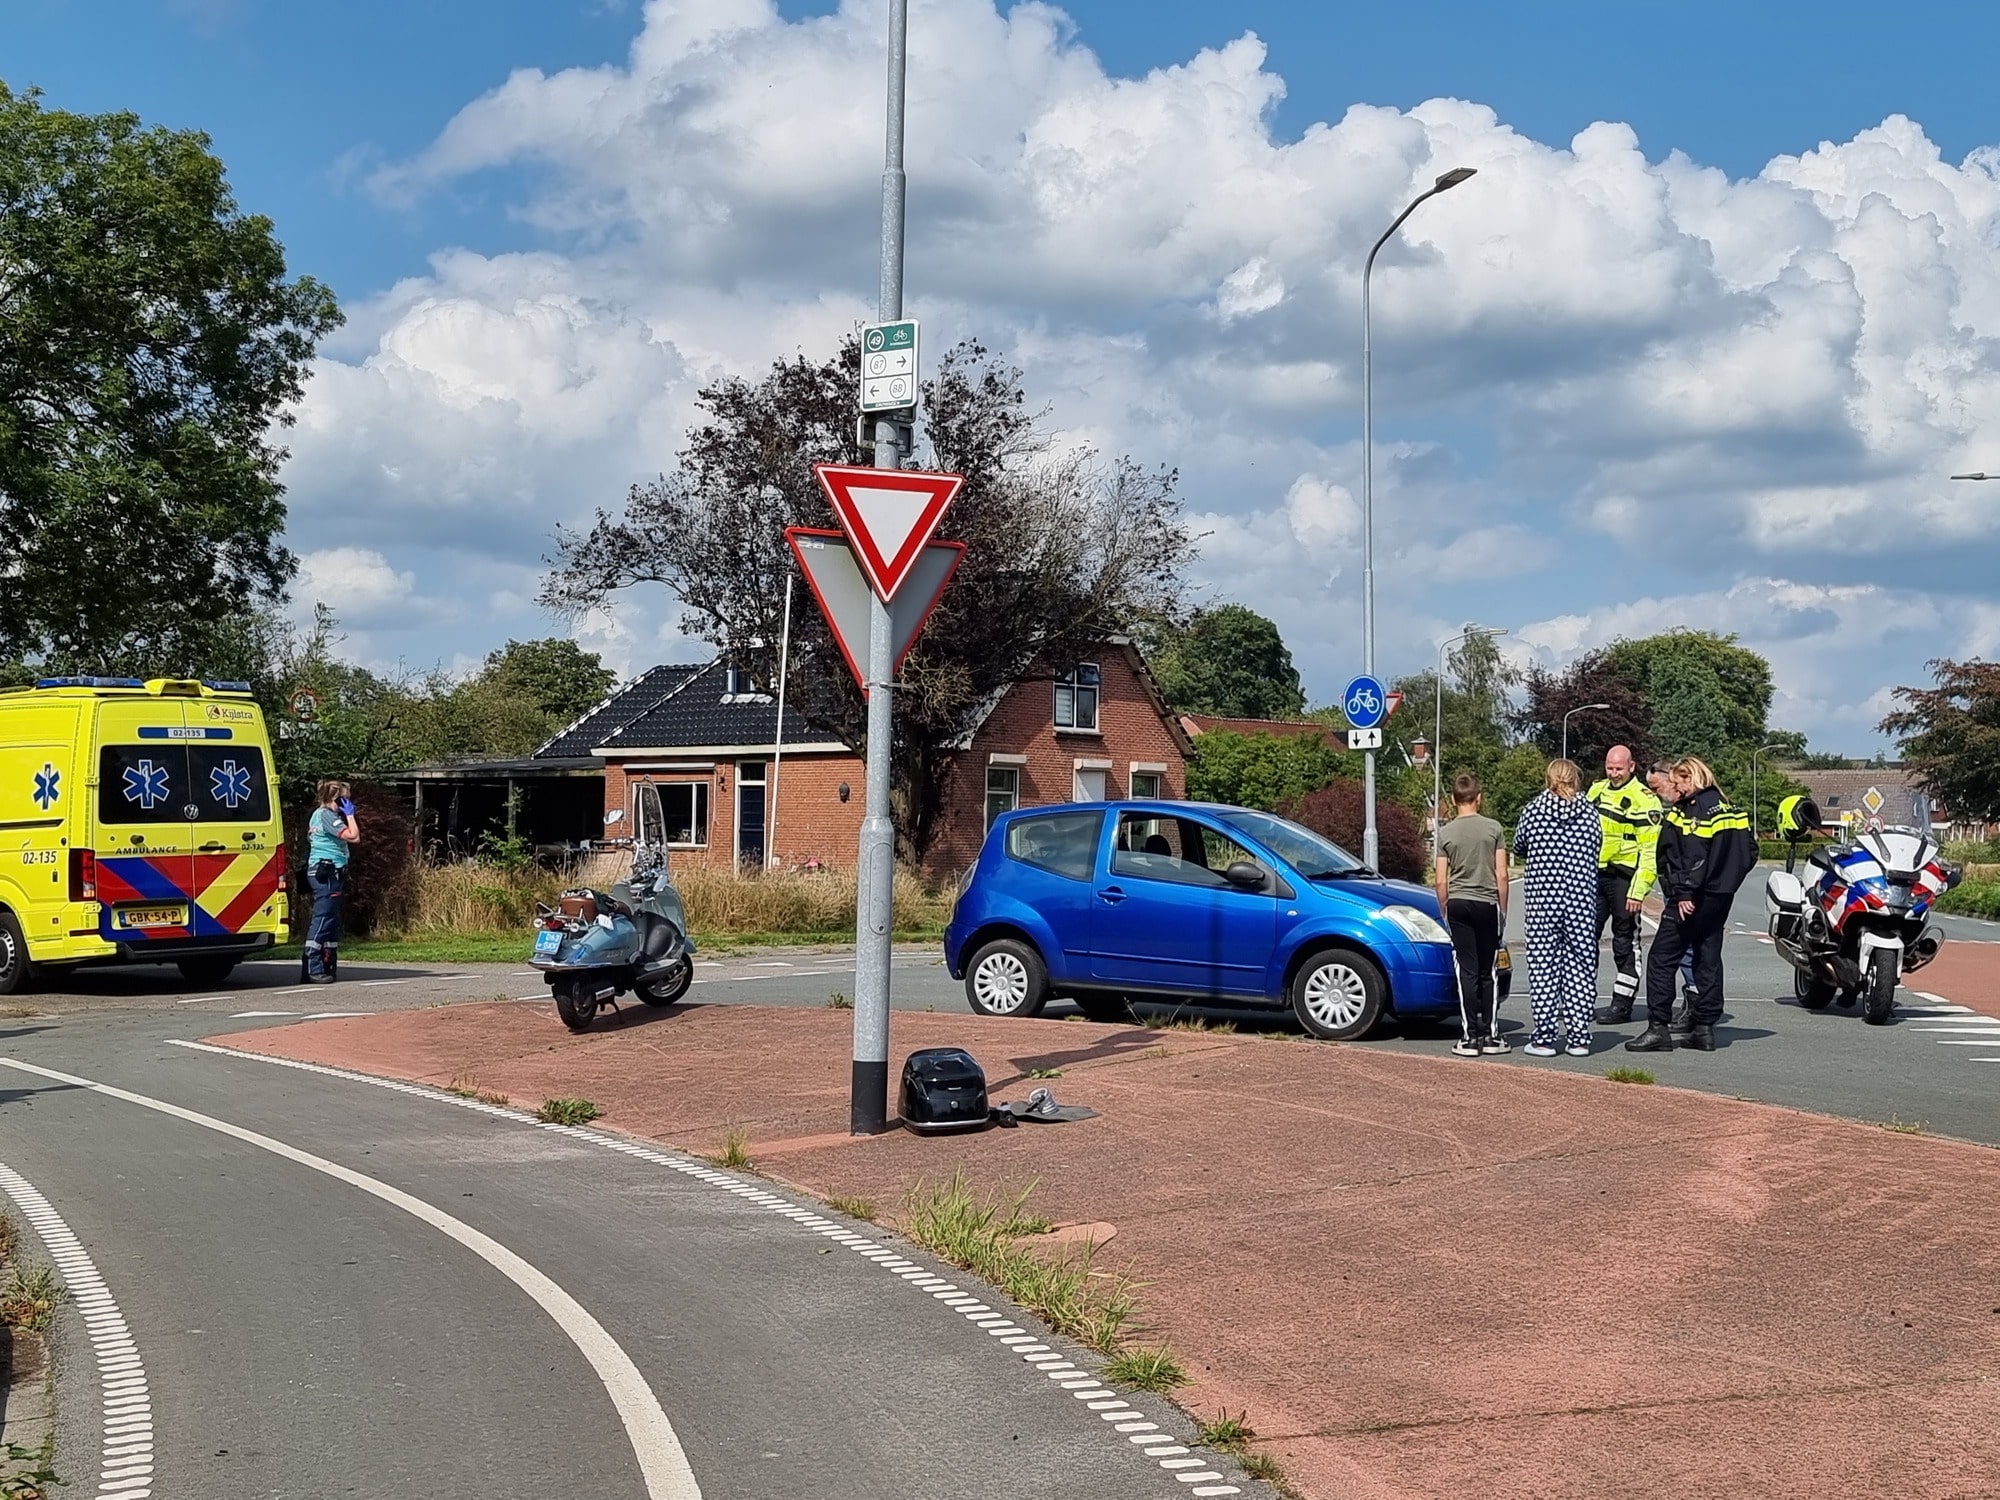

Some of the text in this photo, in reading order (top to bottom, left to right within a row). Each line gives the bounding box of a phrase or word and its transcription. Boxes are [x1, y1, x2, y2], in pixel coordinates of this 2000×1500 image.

[870, 336, 881, 345] 49
[873, 360, 884, 369] 87
[892, 383, 903, 393] 88
[221, 708, 253, 721] Kijlstra
[173, 729, 201, 737] 02-135
[115, 845, 177, 855] AMBULANCE
[241, 843, 265, 851] 02-135
[23, 851, 57, 865] 02-135
[129, 911, 178, 923] GBK-54-P
